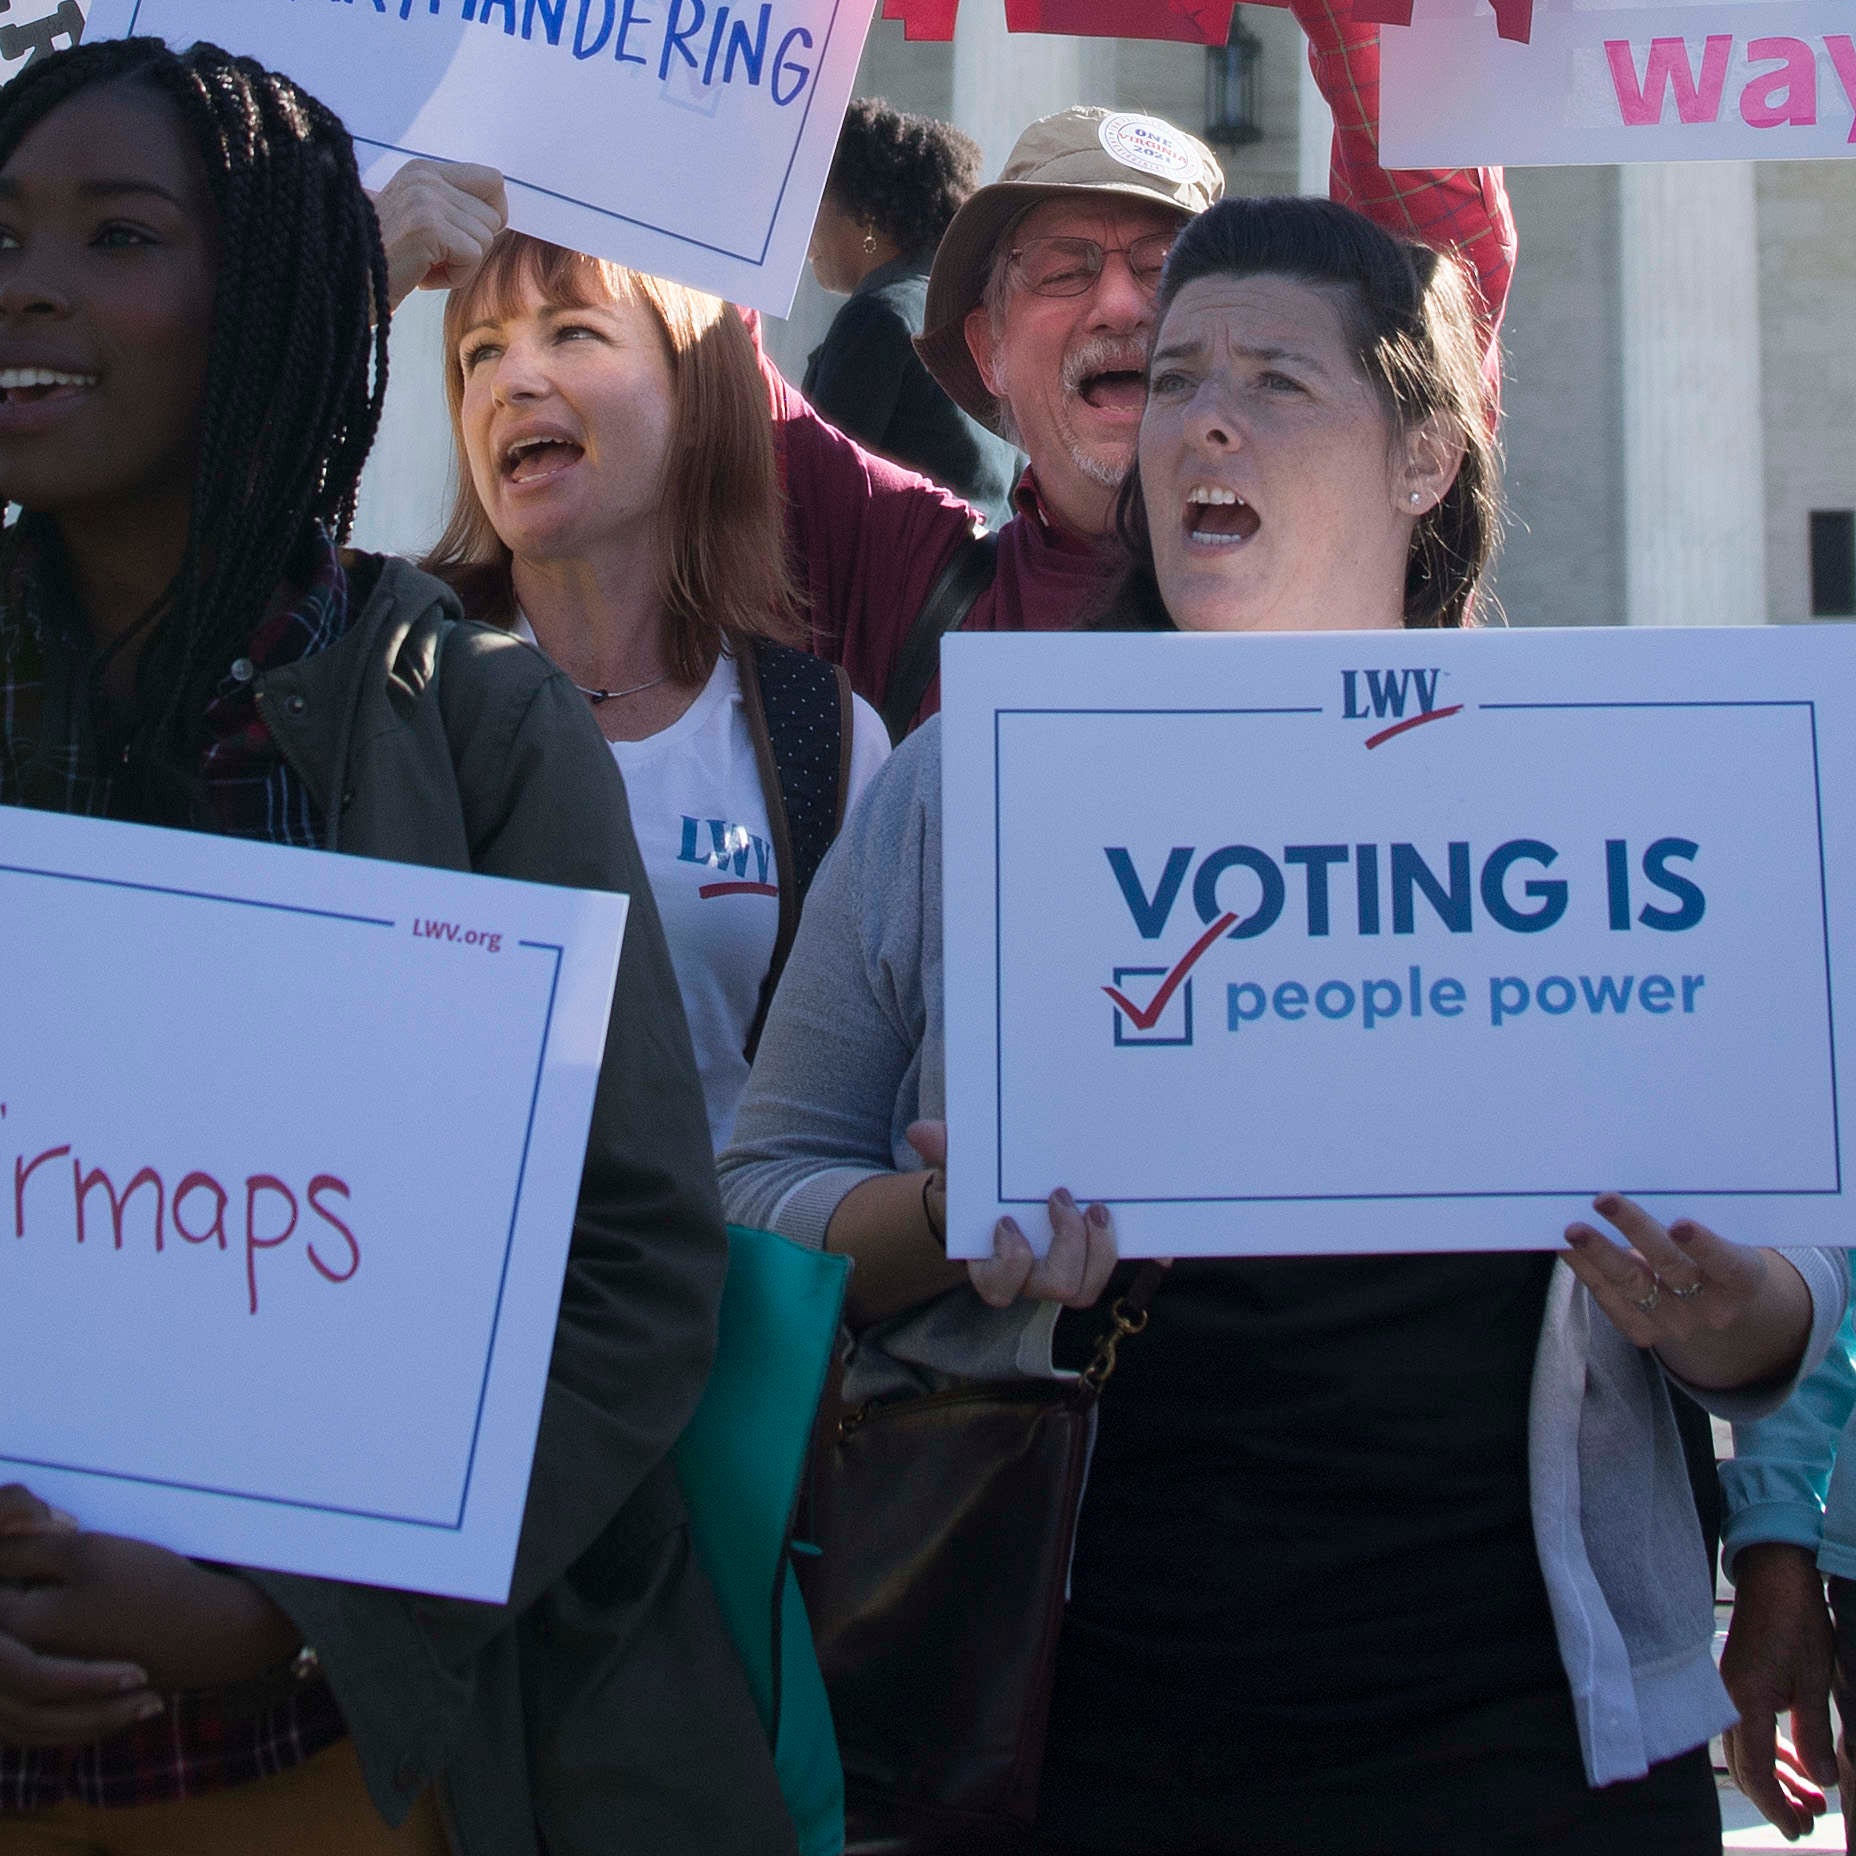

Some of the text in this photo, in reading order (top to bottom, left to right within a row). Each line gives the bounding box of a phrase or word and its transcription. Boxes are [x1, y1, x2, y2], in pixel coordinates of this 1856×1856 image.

[1341, 667, 1441, 721] LWV
[1104, 837, 1708, 940] VOTING IS
[411, 916, 504, 955] LWV.org
[1226, 965, 1706, 1032] people power
